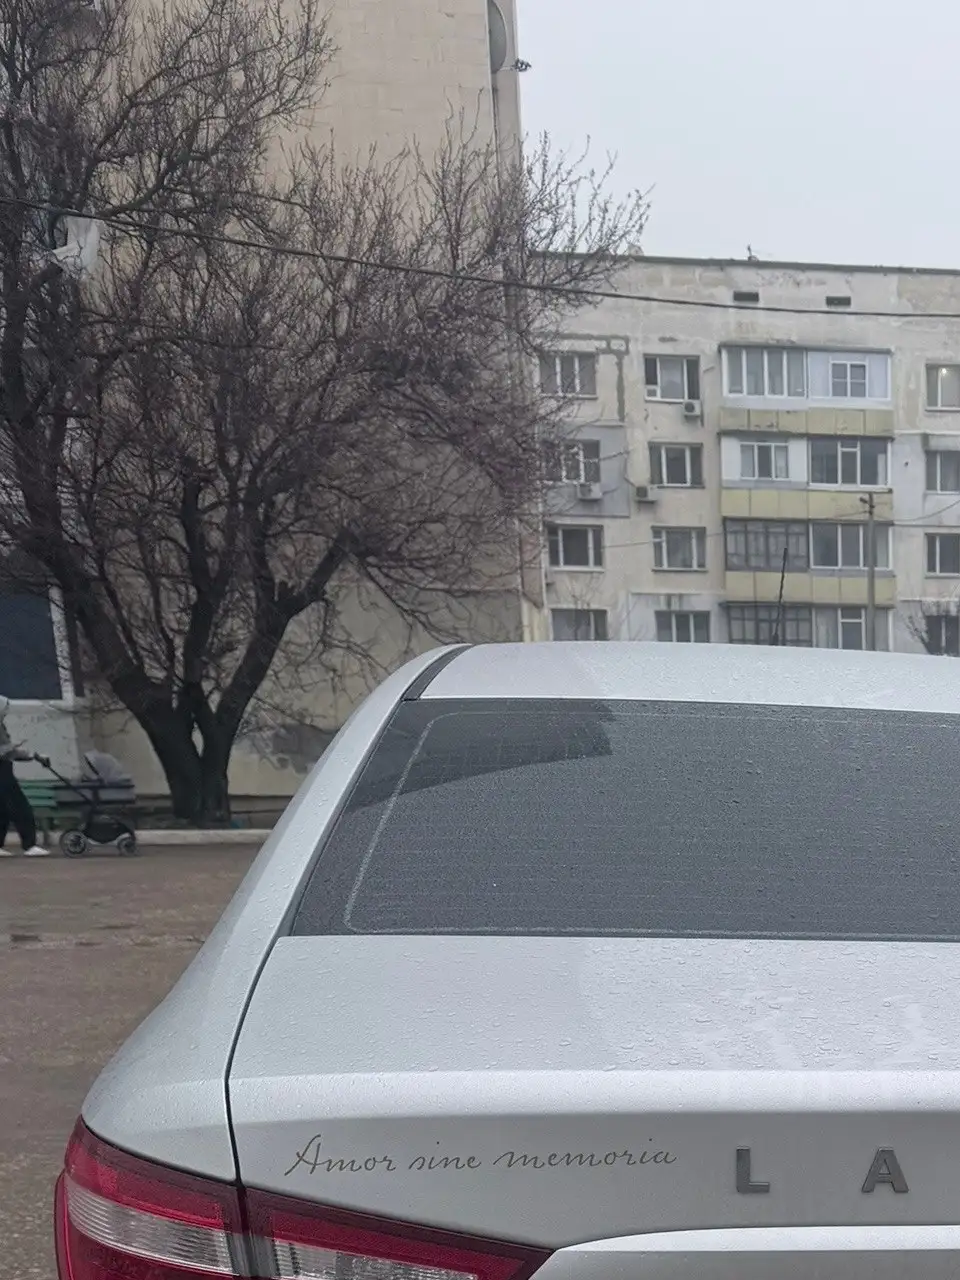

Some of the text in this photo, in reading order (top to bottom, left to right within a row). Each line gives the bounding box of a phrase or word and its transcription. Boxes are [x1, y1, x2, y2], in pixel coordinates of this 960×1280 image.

[284, 1134, 678, 1176] Amor sine memoria
